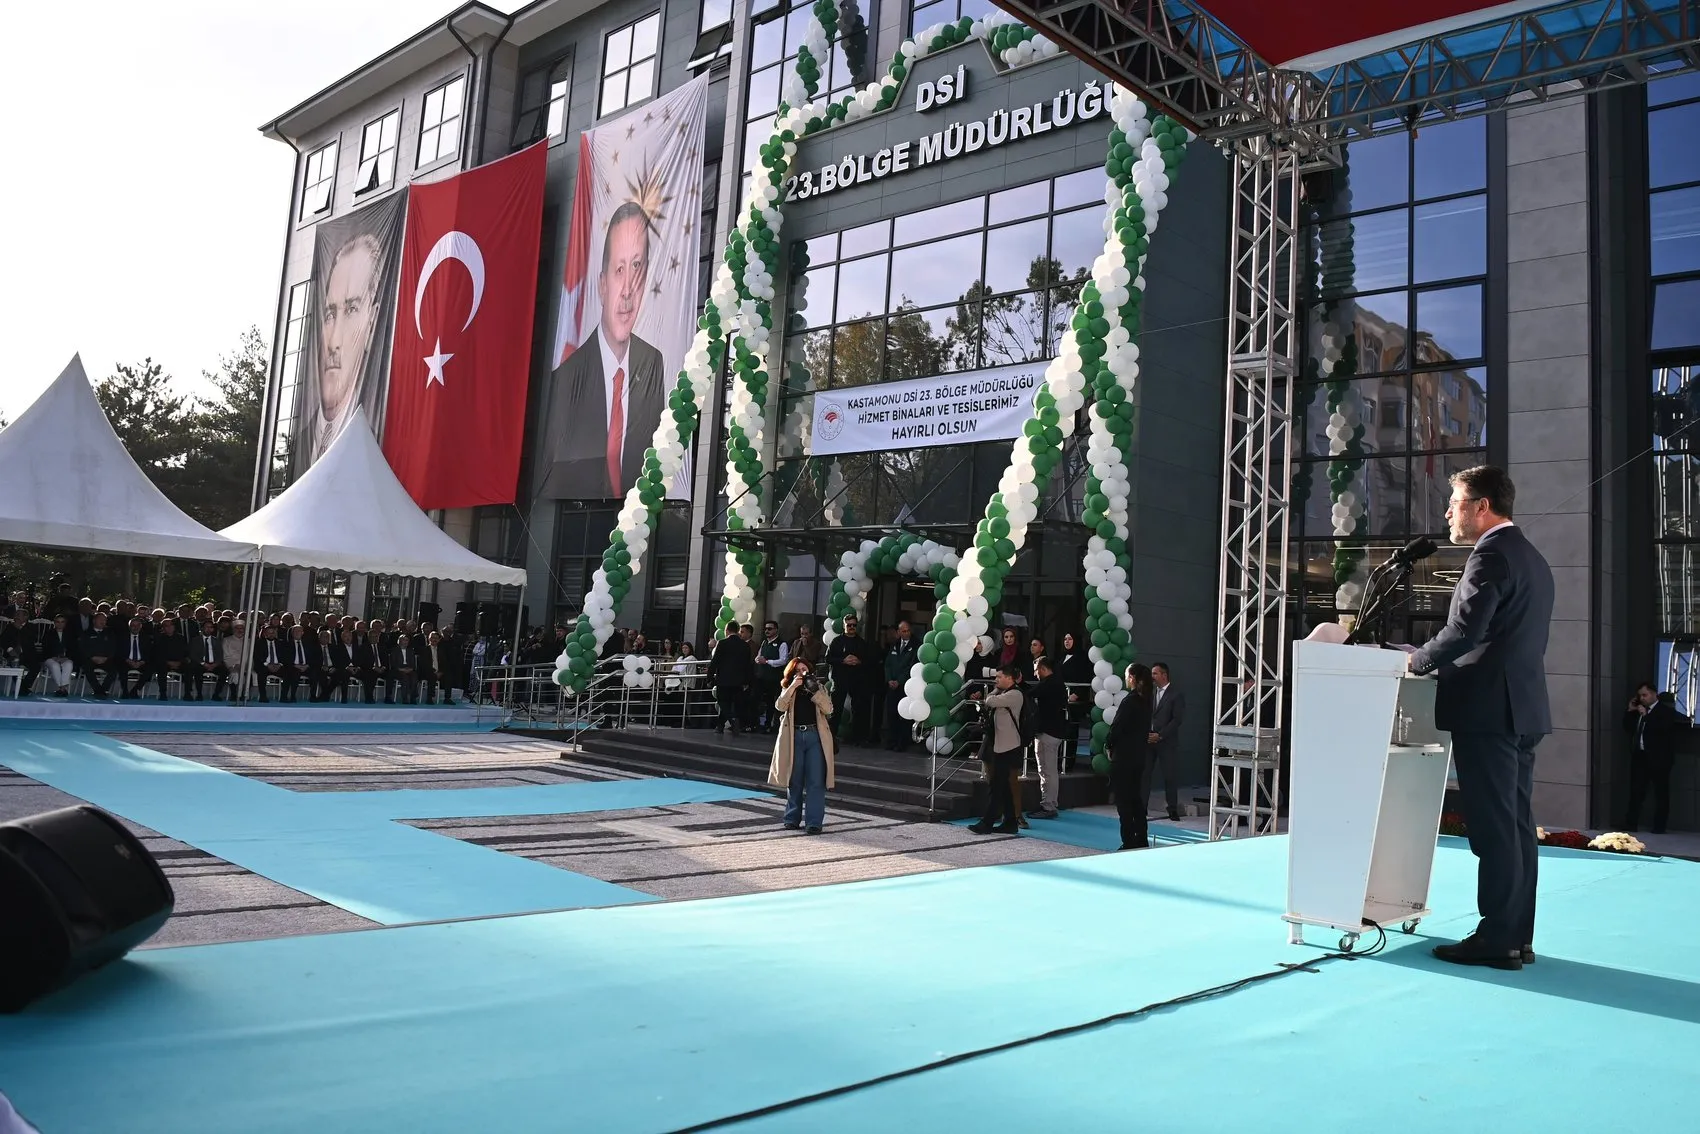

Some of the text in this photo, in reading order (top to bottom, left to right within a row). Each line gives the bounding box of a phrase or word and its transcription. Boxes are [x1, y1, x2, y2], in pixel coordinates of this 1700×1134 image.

[916, 63, 966, 112] DSİ
[847, 374, 1034, 410] KASTAMONU DSİ 23. BÖLGE MÜDÜRLÜĞÜ
[858, 394, 1020, 424] HİZMET BİNALARI VE TESİSLERİMİZ
[891, 419, 978, 440] HAYIRLI OLSUN
